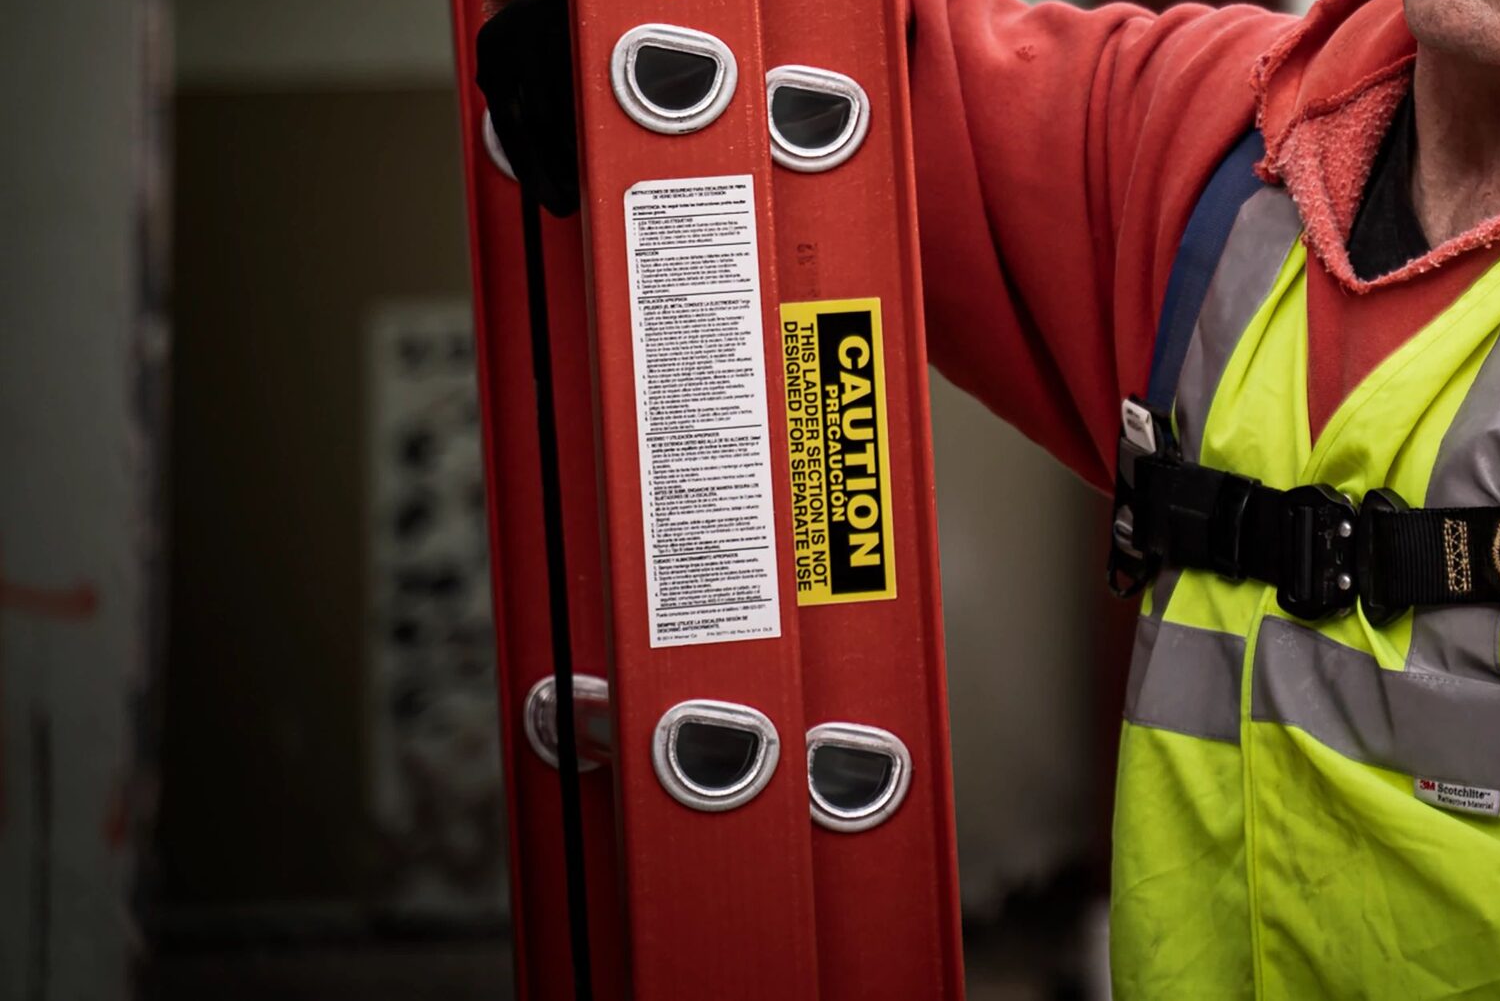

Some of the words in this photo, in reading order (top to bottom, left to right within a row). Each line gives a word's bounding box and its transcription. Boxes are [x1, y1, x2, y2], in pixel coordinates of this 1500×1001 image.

[784, 321, 804, 412] DESIGNED
[800, 322, 815, 364] THIS
[802, 368, 819, 441] LADDER
[789, 418, 804, 454] FOR
[825, 384, 845, 523] PRECAUCIÓN
[838, 335, 881, 568] CAUTION
[791, 458, 810, 552] SEPARATE
[806, 445, 825, 524] SECTION
[811, 528, 825, 546] IS
[796, 554, 812, 592] USE
[812, 549, 828, 587] NOT
[1419, 779, 1436, 791] 3M
